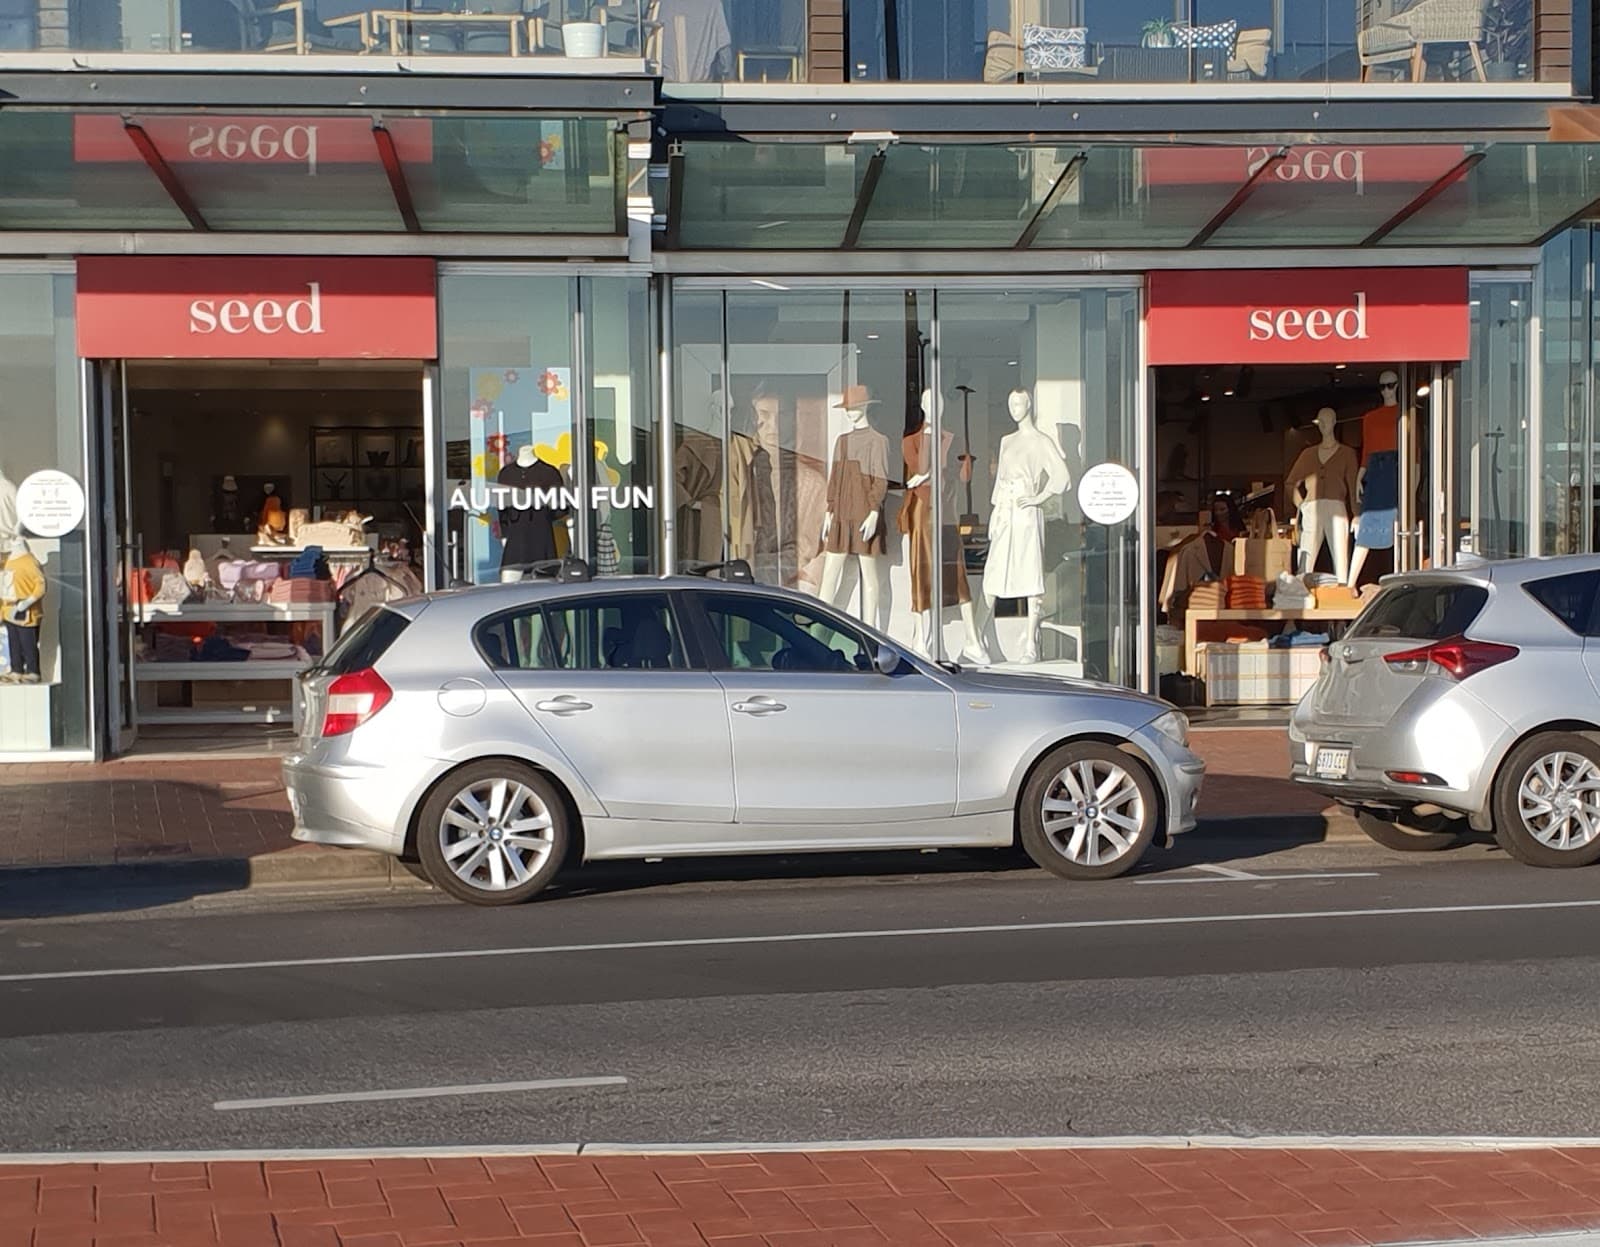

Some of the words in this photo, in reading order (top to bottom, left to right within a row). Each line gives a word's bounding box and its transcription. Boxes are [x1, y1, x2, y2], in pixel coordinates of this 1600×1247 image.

[189, 282, 325, 334] seed
[1249, 291, 1368, 341] seed
[450, 486, 579, 511] AUTUMN
[591, 485, 654, 510] FUN
